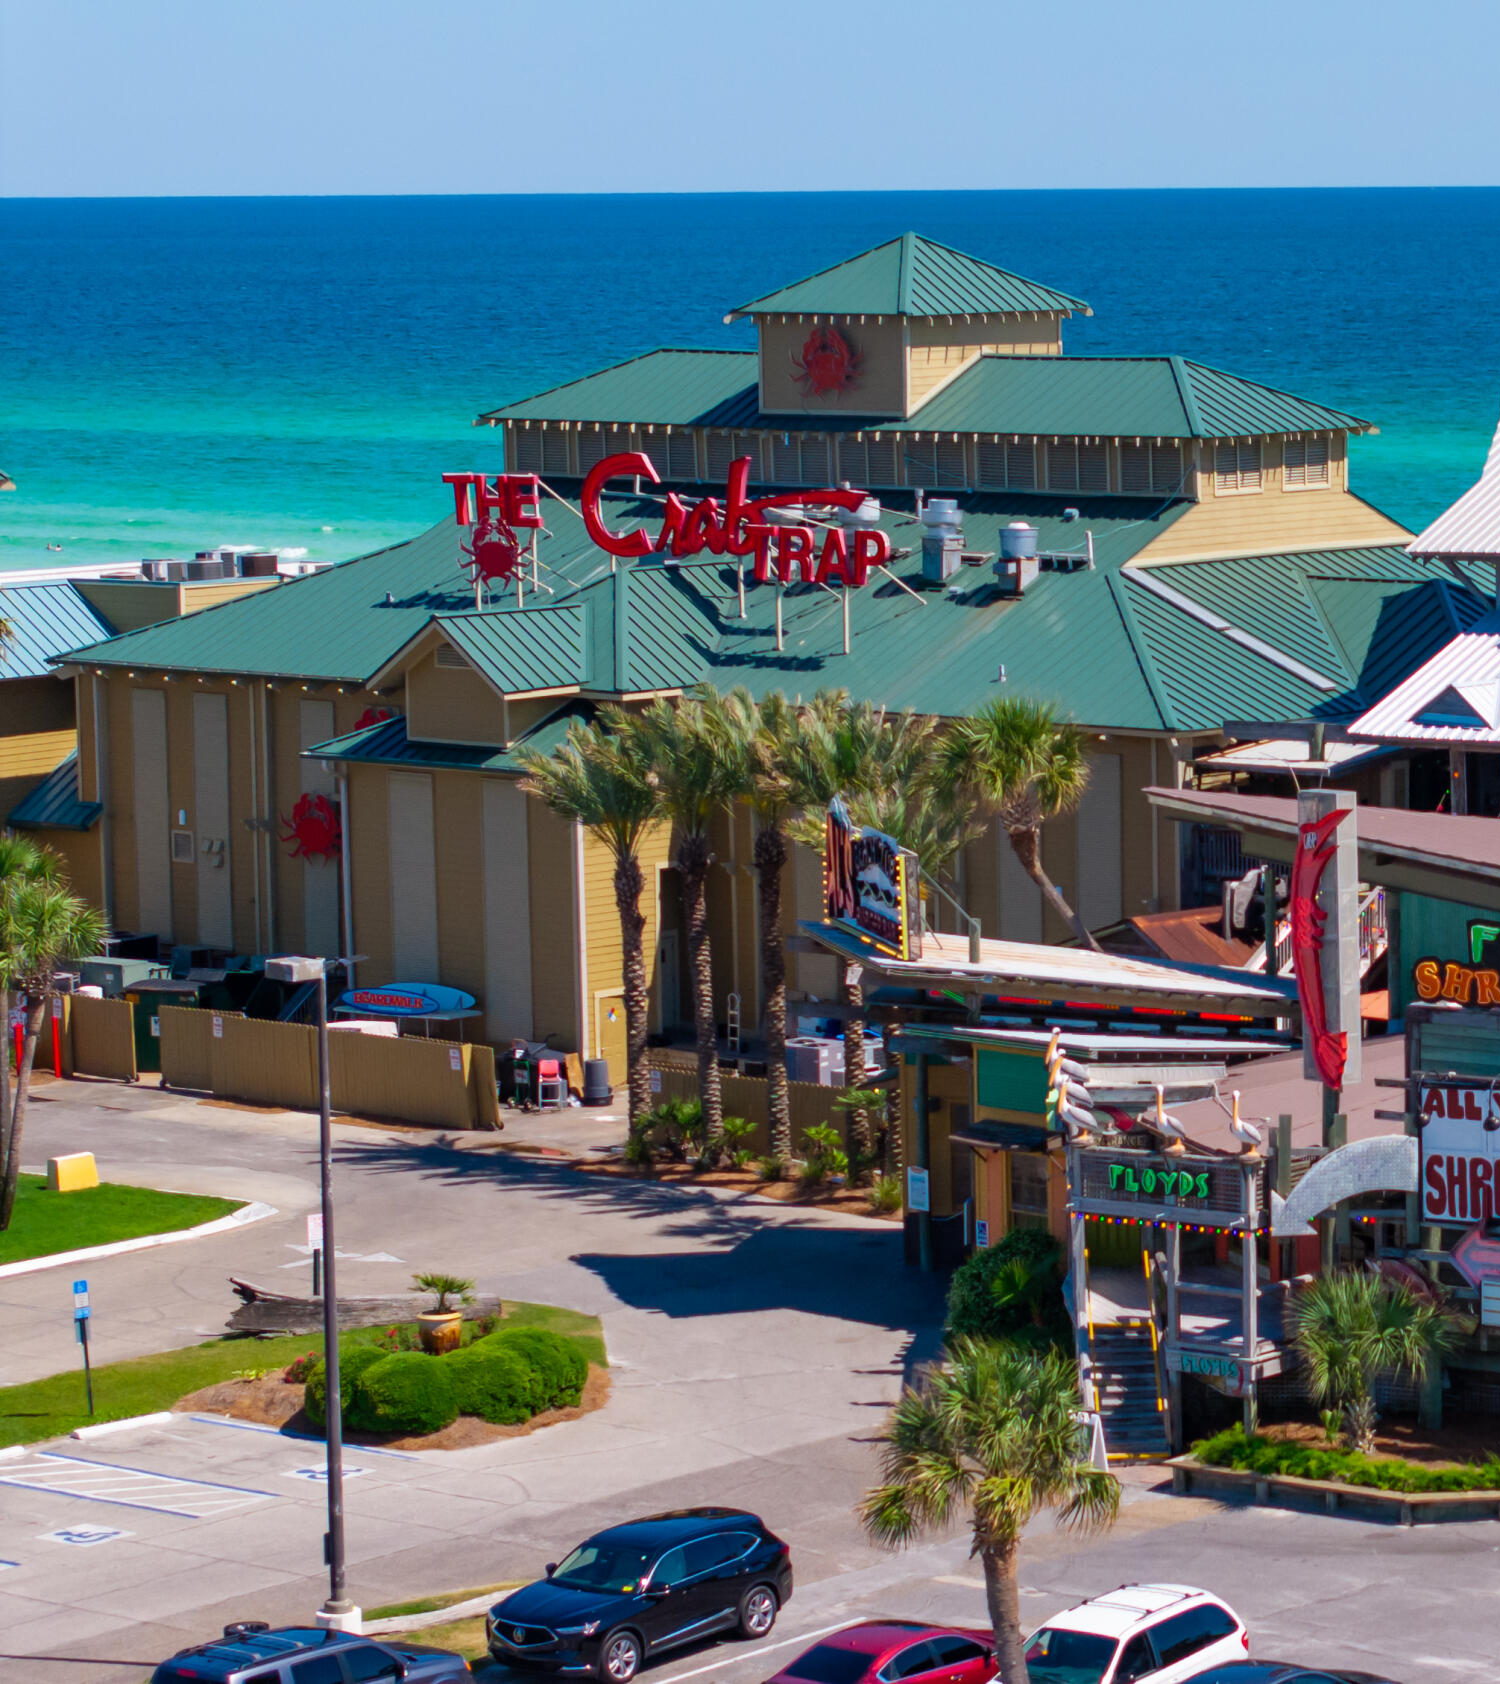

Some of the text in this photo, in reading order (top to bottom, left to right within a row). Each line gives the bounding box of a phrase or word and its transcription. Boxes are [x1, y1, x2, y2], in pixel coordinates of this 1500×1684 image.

[442, 451, 870, 557] THE Crab
[746, 525, 891, 586] TRAP
[1424, 1088, 1482, 1121] ALL
[1108, 1164, 1209, 1198] FLOYDS
[1181, 1355, 1239, 1377] FLOYDS
